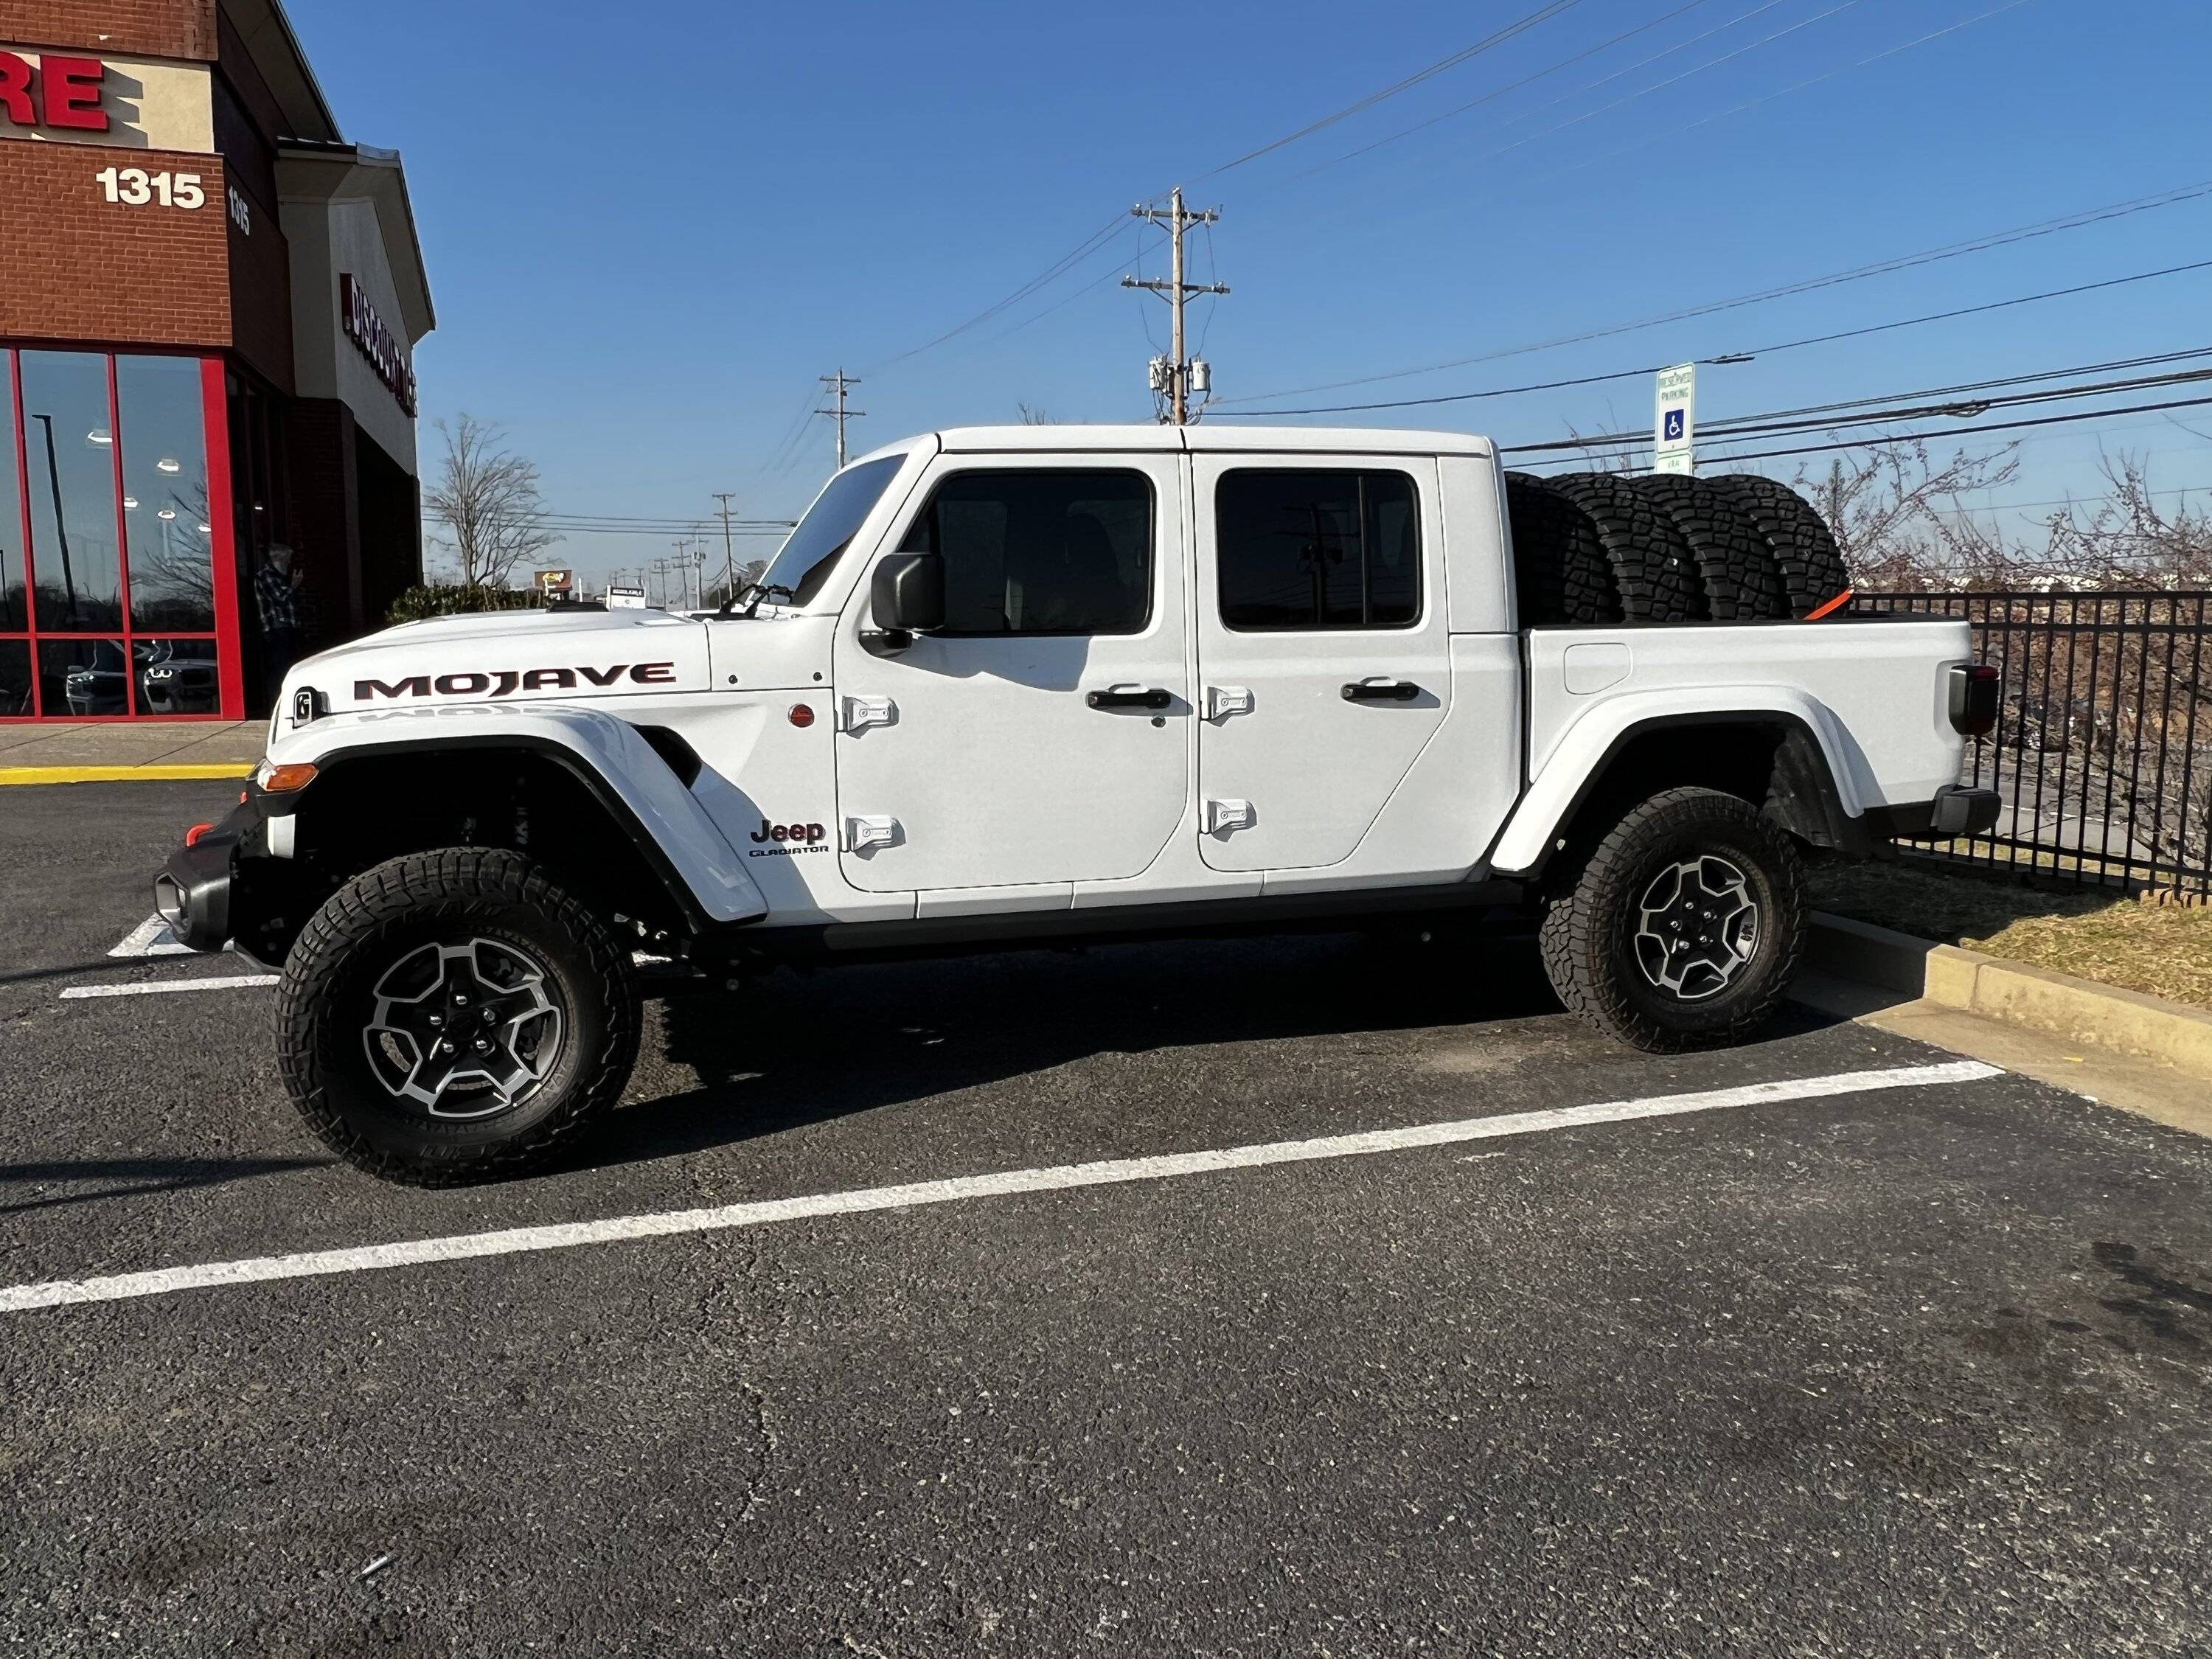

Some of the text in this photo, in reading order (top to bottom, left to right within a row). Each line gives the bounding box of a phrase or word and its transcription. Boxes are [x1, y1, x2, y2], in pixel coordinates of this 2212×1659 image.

[96, 167, 205, 209] 1315
[229, 185, 249, 235] 1315
[354, 661, 677, 700] MOJAVE
[749, 846, 829, 857] GLADIATOR
[751, 819, 826, 845] Jeep
